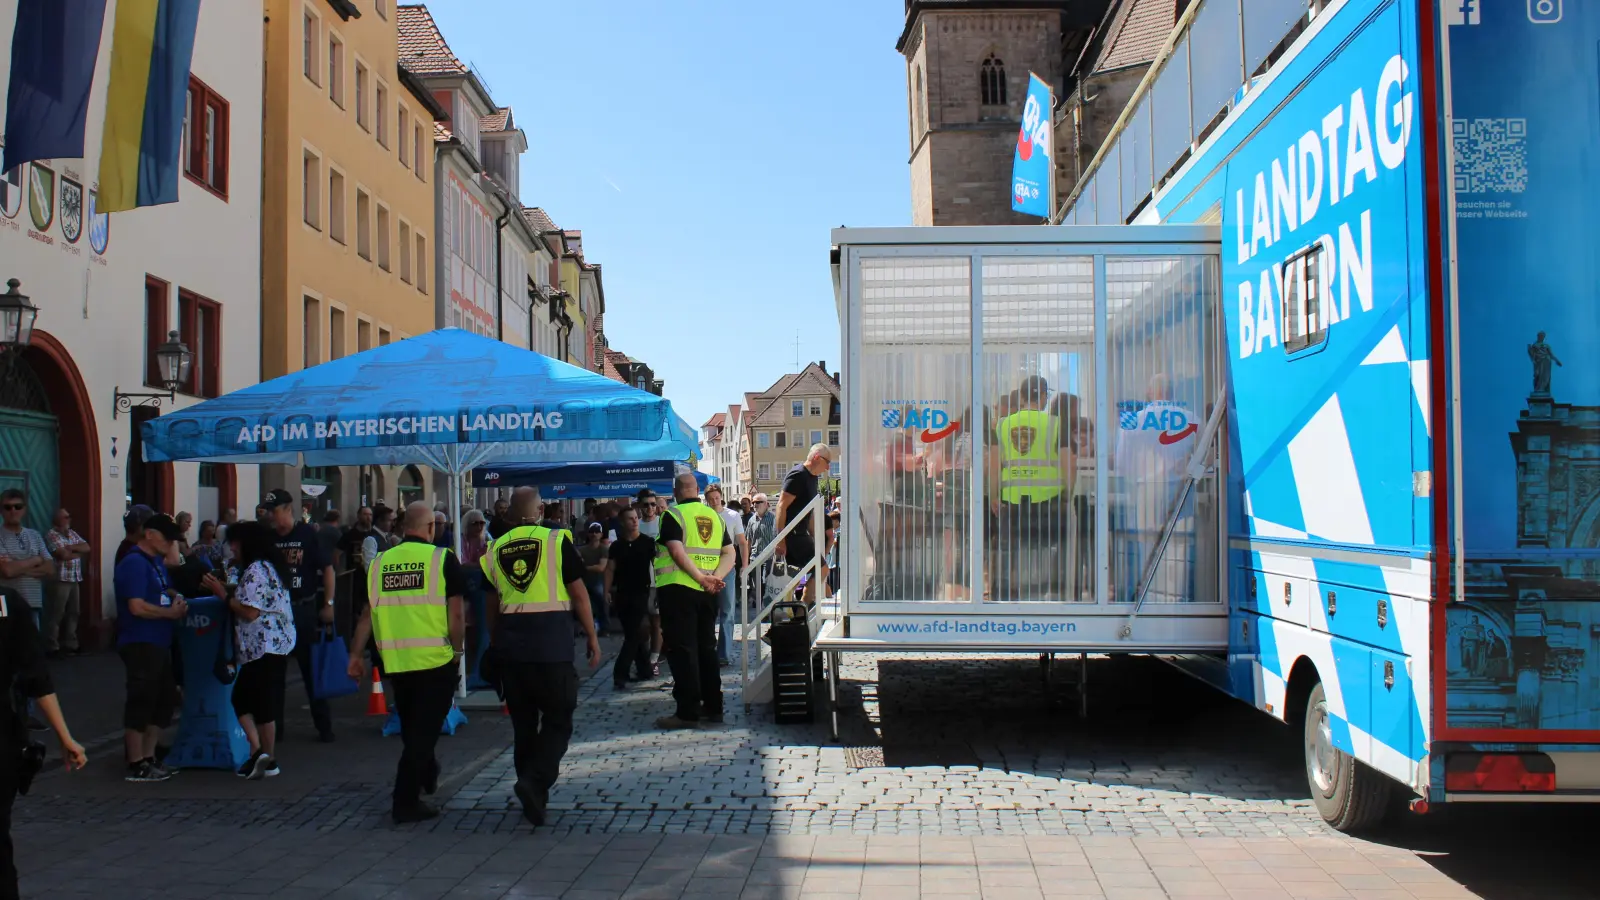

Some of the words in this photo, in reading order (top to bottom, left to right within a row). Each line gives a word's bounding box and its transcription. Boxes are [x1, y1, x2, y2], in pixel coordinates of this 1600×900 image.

[1236, 54, 1413, 265] LANDTAG
[1455, 200, 1496, 208] esuchen
[1455, 210, 1483, 218] nsere
[1238, 209, 1373, 359] BAYERN
[903, 407, 949, 429] AfD
[1141, 409, 1187, 431] AfD
[236, 424, 276, 444] AfD
[282, 422, 309, 441] IM
[315, 415, 455, 439] BAYERISCHEN
[462, 411, 564, 431] LANDTAG
[484, 471, 500, 481] AfD
[502, 543, 536, 554] SEKTOR
[382, 562, 425, 572] SEKTOR
[384, 573, 421, 588] SECURITY
[876, 620, 1077, 635] www.afd-landtag.bayern
